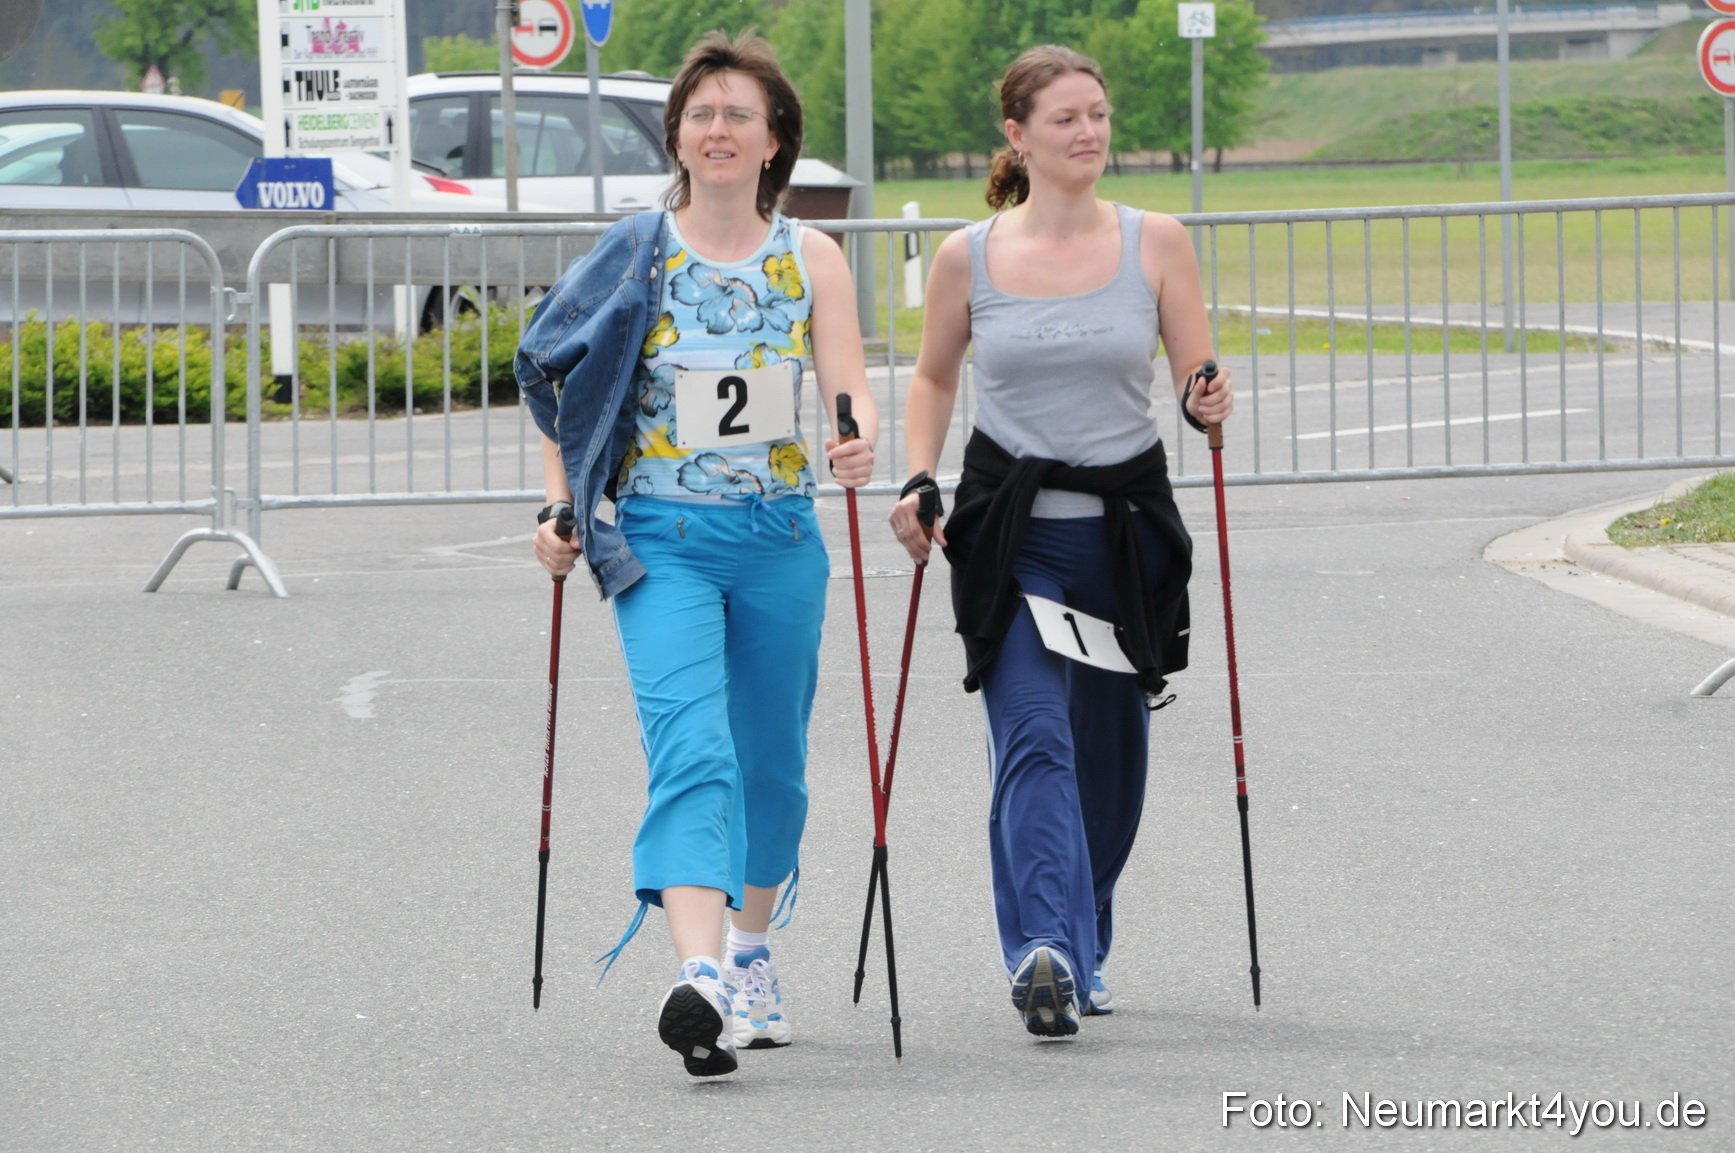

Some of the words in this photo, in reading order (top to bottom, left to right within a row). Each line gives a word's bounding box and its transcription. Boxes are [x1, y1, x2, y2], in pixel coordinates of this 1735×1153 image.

[295, 69, 341, 102] THULE
[256, 181, 325, 209] VOLVO
[717, 375, 750, 437] 2
[1062, 611, 1090, 658] 1
